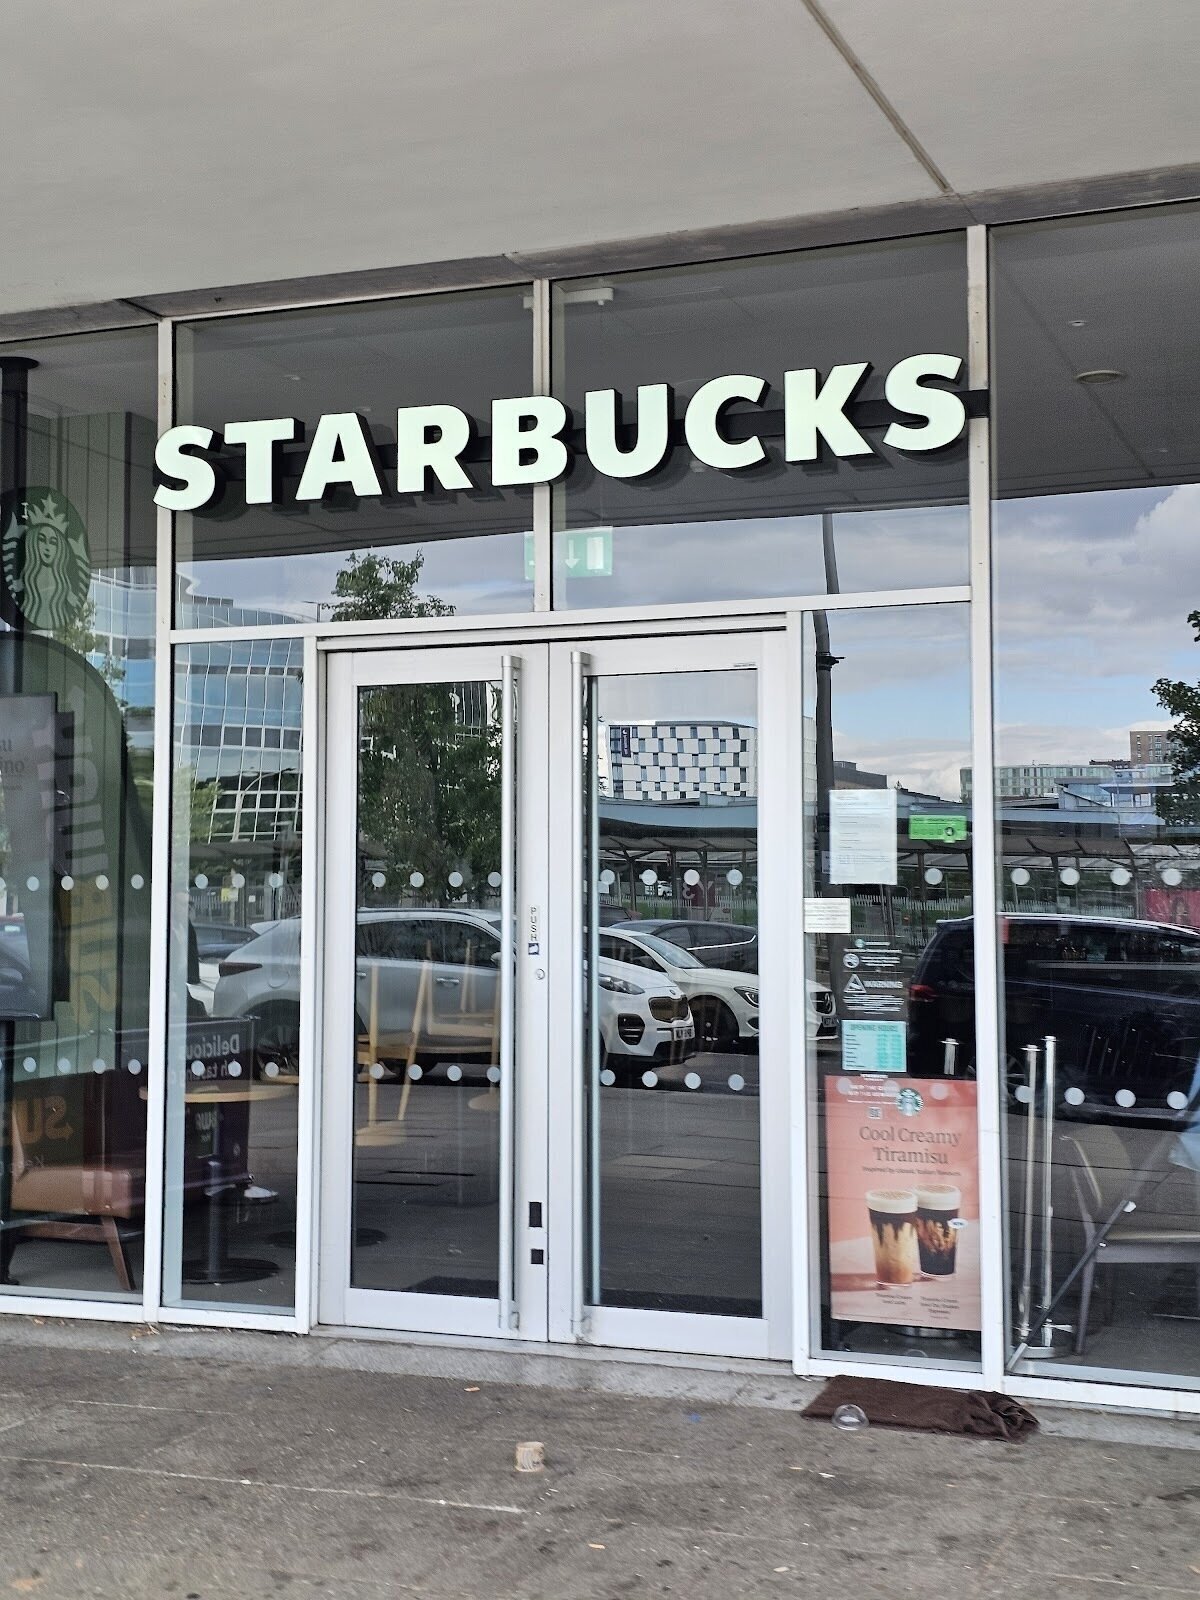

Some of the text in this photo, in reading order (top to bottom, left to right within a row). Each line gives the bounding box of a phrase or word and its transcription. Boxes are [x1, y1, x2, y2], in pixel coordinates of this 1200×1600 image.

[152, 352, 968, 512] STARBUCKS
[530, 906, 538, 942] PUSH
[859, 1125, 962, 1147] Cool Creamy
[873, 1146, 949, 1165] Tiramisu
